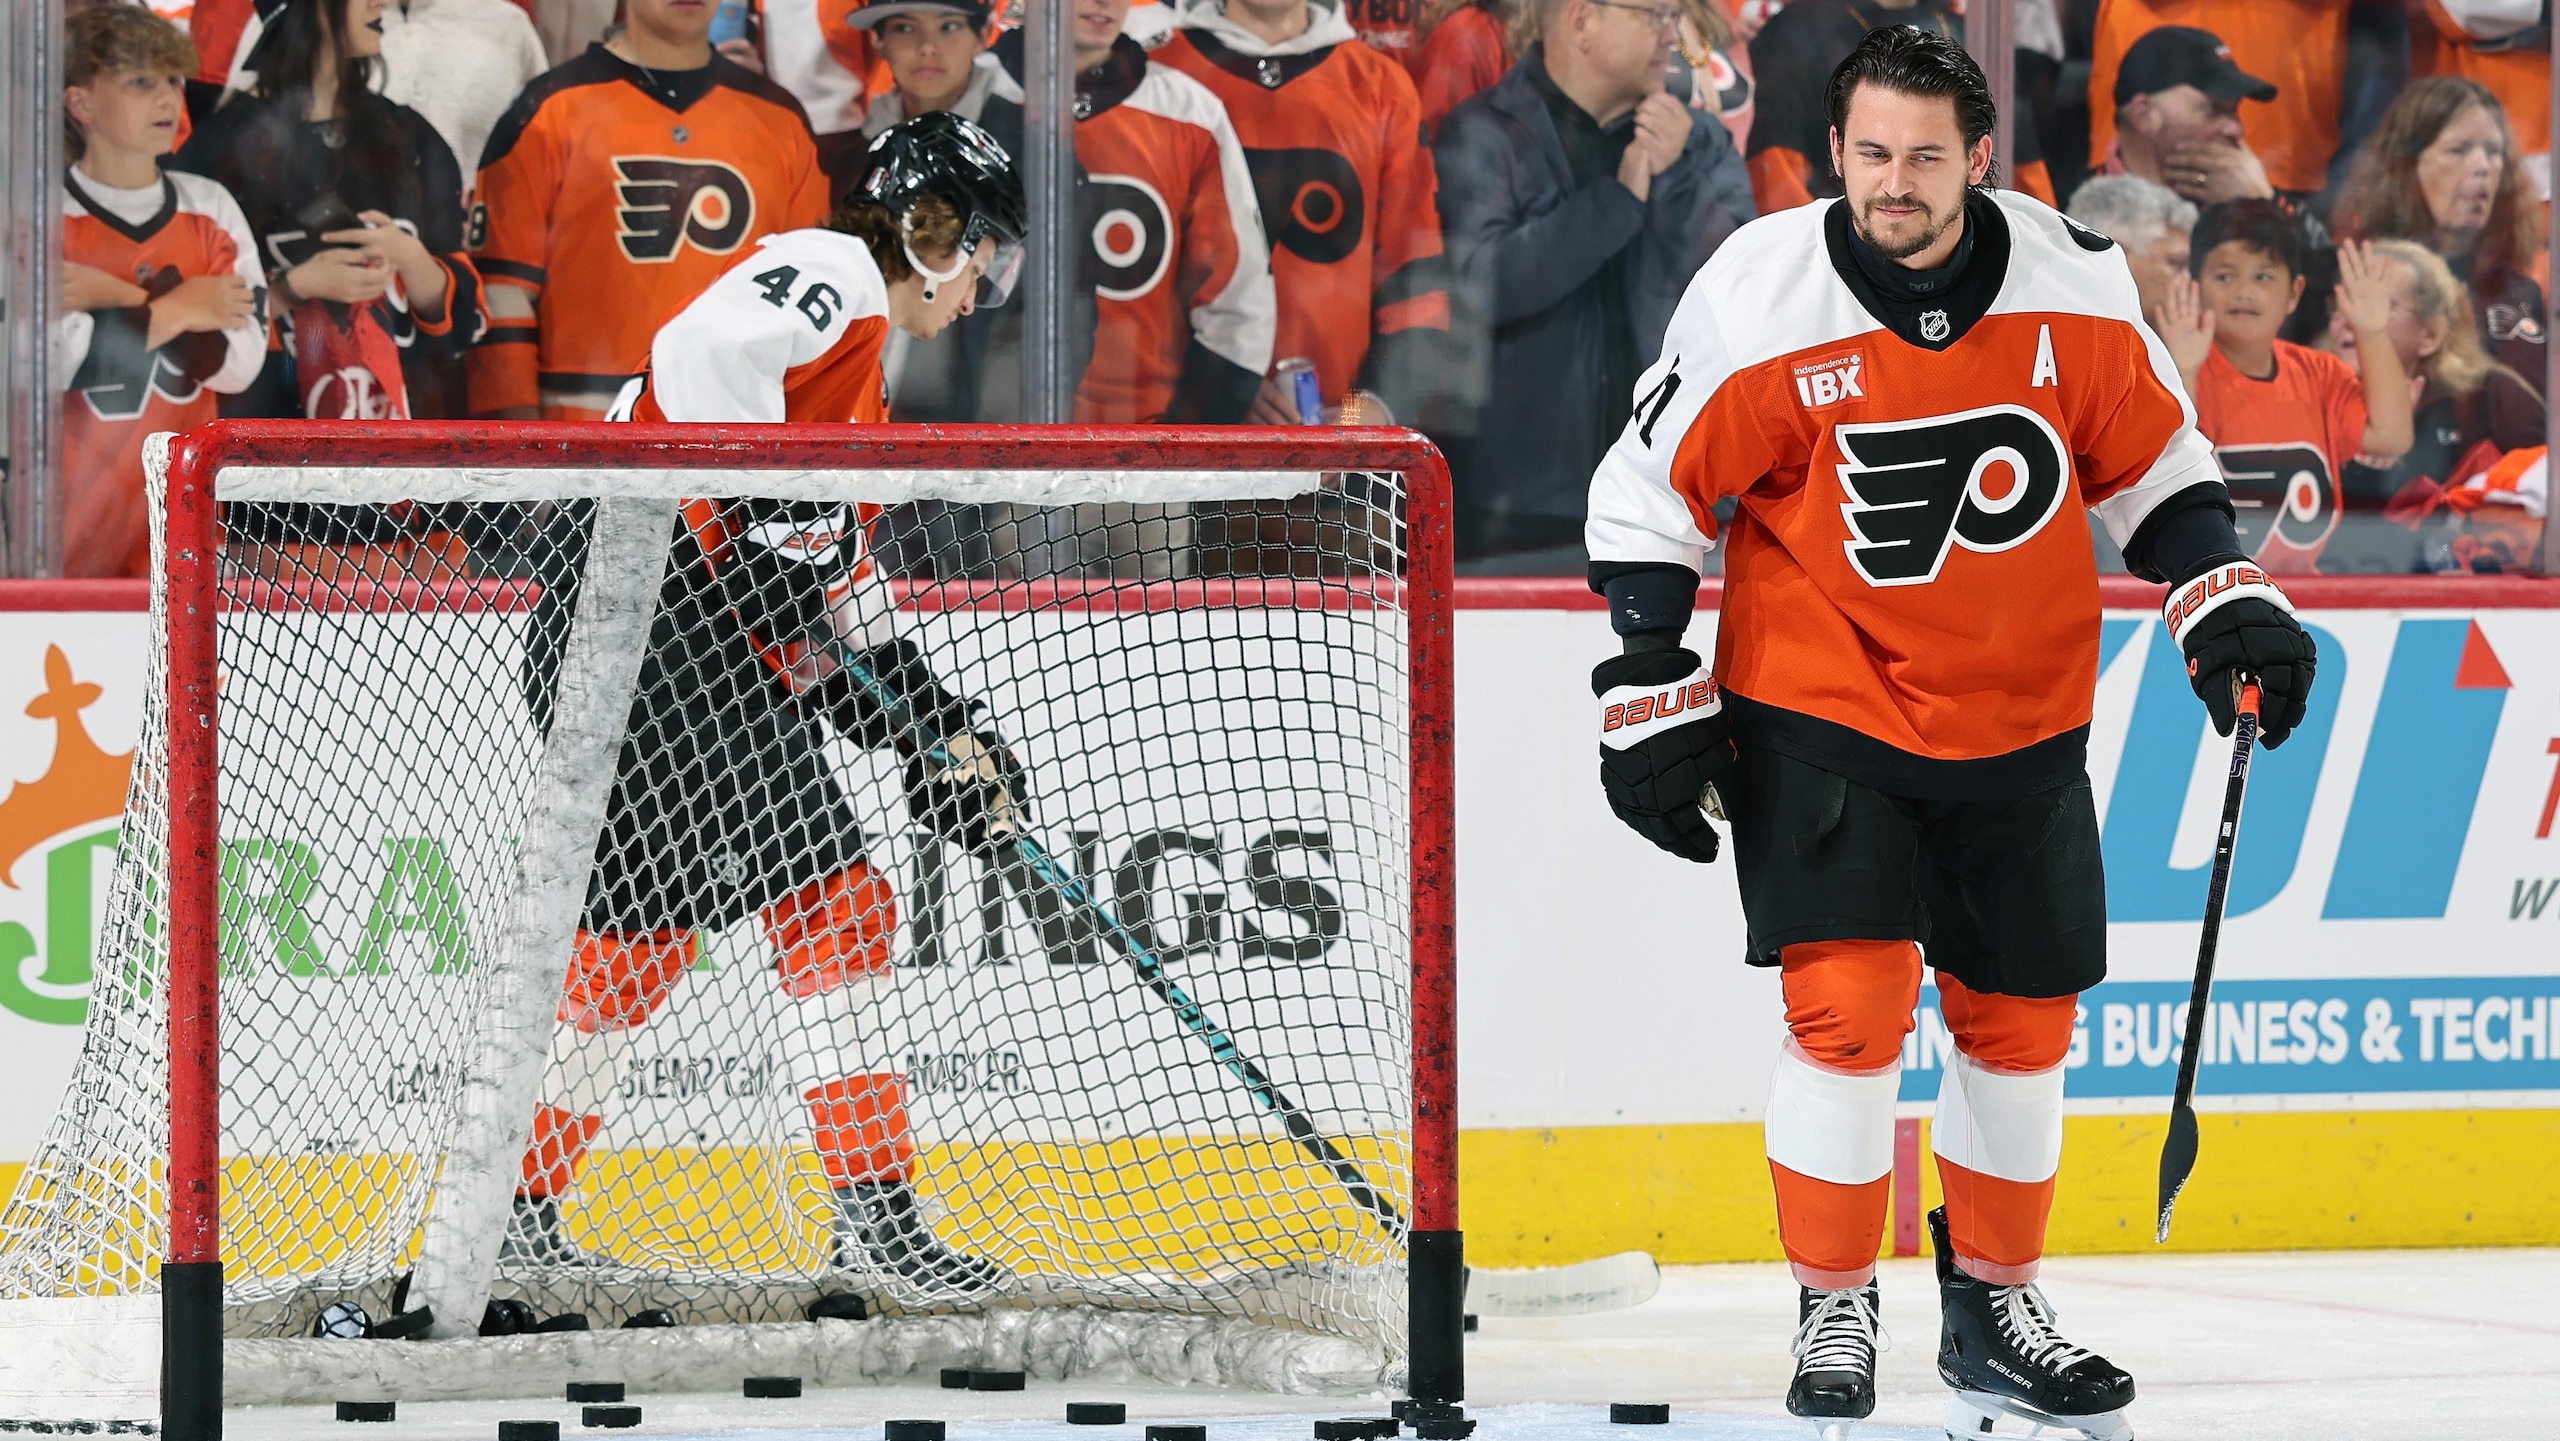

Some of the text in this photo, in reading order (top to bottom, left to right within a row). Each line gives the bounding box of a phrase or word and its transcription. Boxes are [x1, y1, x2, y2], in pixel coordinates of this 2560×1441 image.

[752, 265, 842, 333] 46
[1793, 356, 1849, 376] Independence
[1796, 365, 1864, 407] IBX
[2031, 323, 2058, 388] A
[2103, 998, 2350, 1067] BUSINESS
[2360, 997, 2403, 1063] &
[2409, 996, 2560, 1062] TECH
